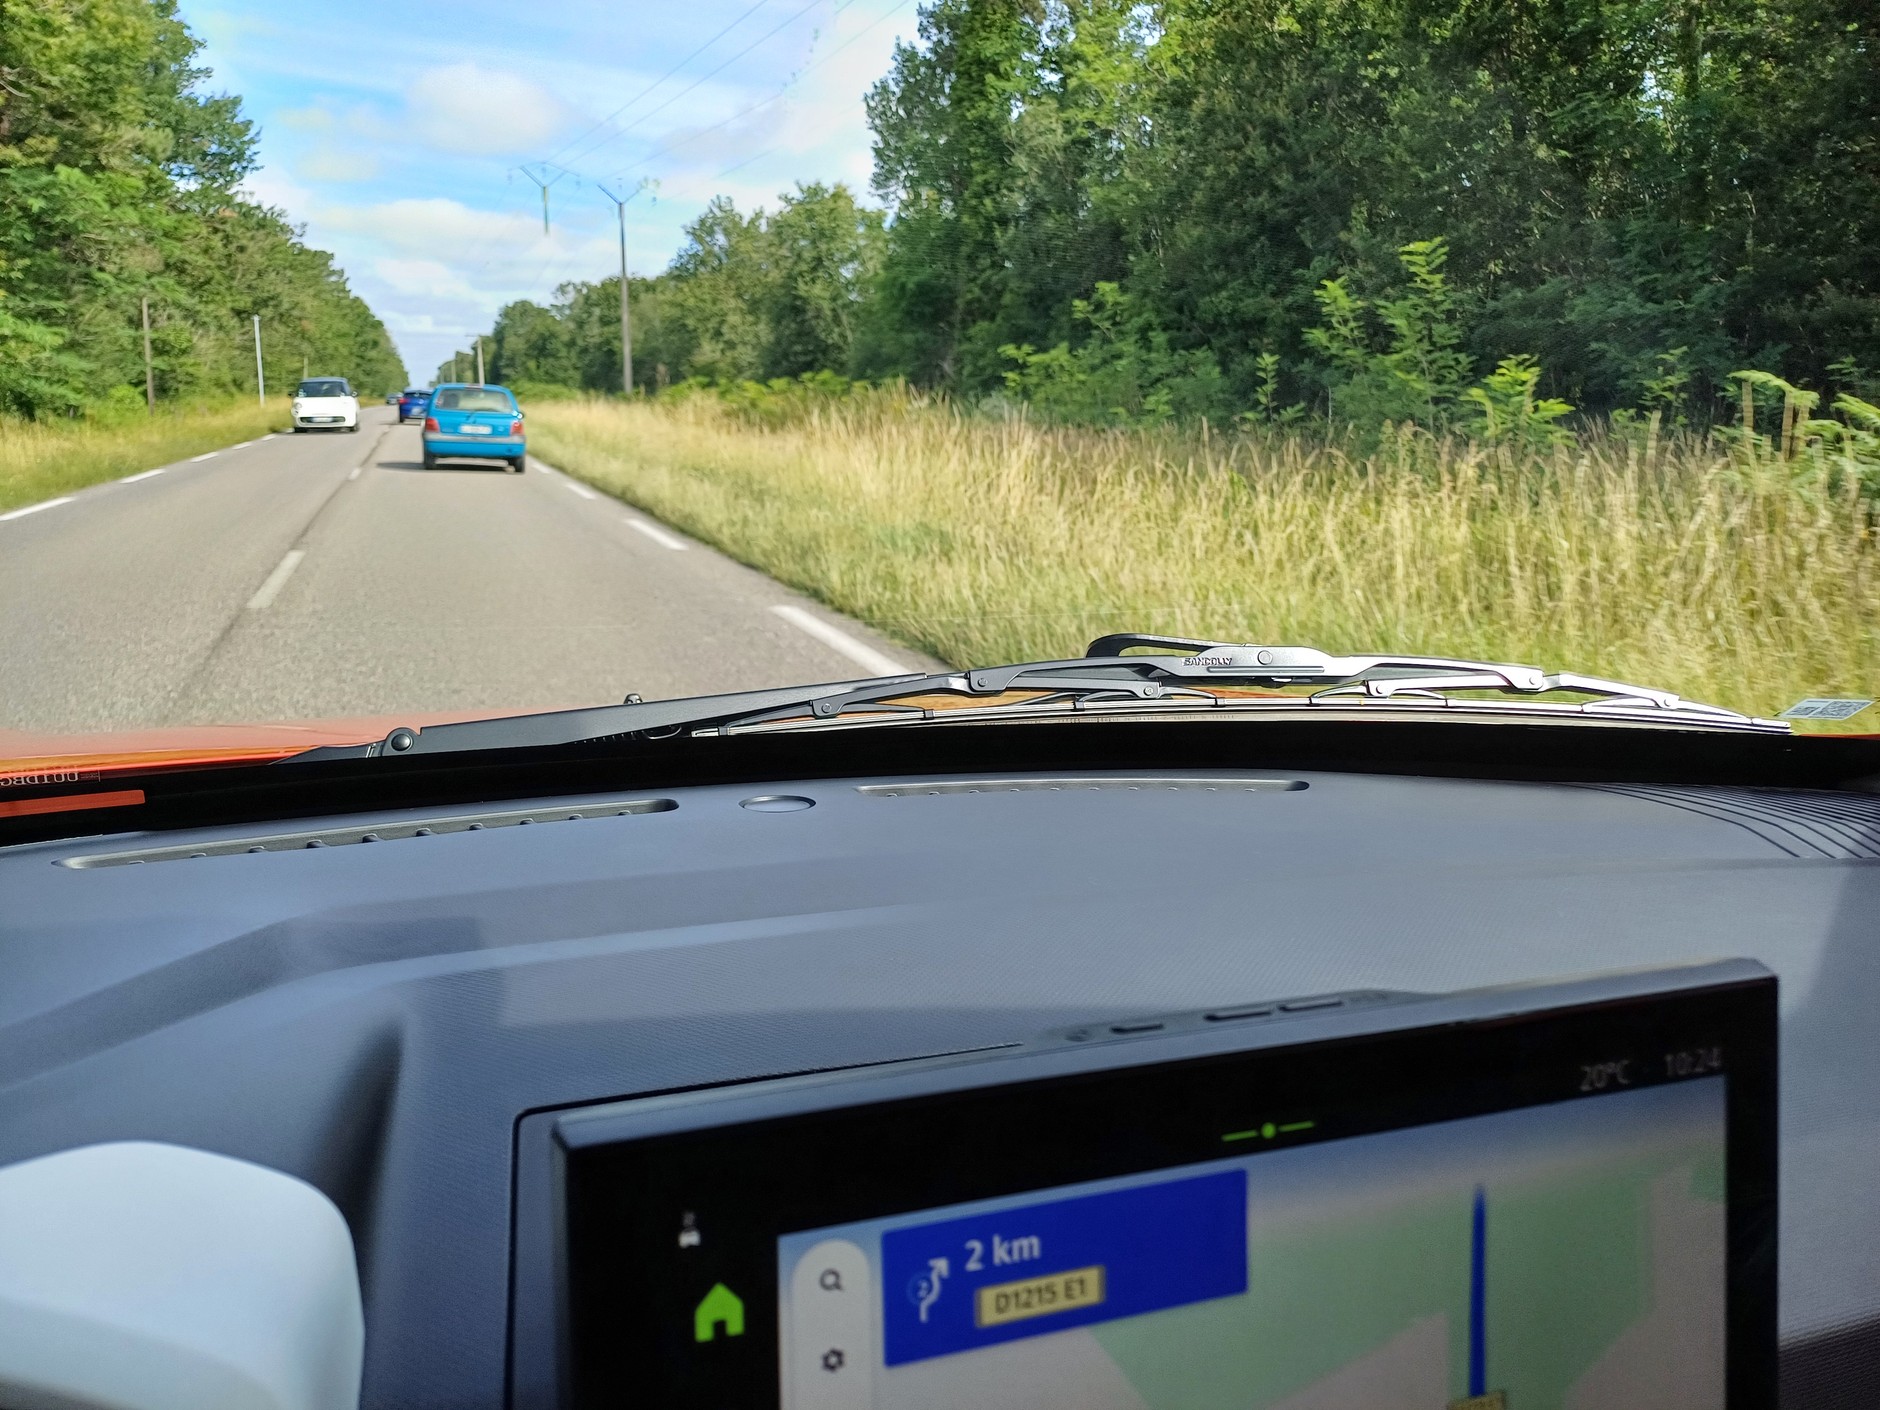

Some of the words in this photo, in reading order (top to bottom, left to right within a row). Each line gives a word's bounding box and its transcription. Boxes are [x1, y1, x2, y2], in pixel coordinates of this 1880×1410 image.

[964, 1239, 985, 1271] 2
[993, 1234, 1041, 1266] km
[994, 1281, 1058, 1315] D1215
[1064, 1276, 1088, 1301] E1
